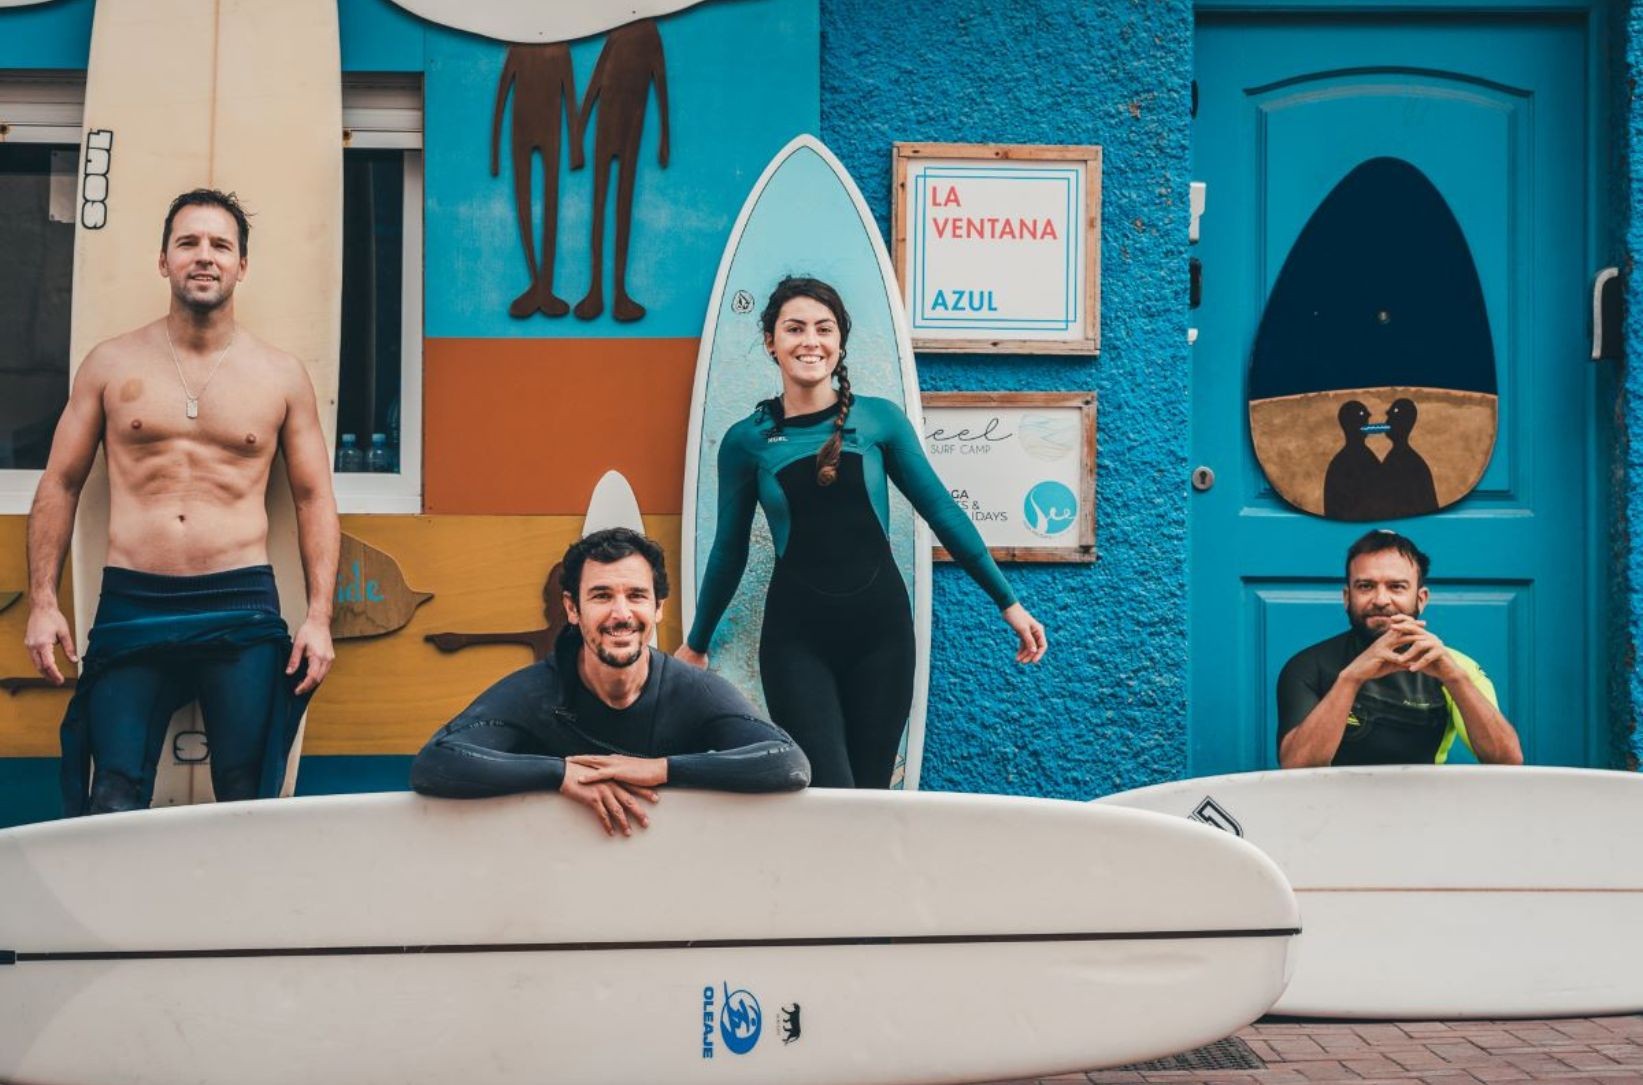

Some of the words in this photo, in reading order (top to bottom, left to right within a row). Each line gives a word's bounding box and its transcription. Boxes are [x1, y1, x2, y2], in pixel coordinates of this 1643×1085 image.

[931, 186, 961, 207] LA
[932, 217, 1058, 240] VENTANA
[931, 289, 998, 311] AZUL
[923, 417, 1013, 441] eel
[930, 444, 956, 455] SURF
[960, 444, 991, 455] CAMP
[951, 489, 969, 499] GA
[971, 500, 980, 510] &
[971, 511, 1008, 521] IDAYS
[336, 560, 385, 604] ide
[702, 985, 715, 1059] OLEAJE
